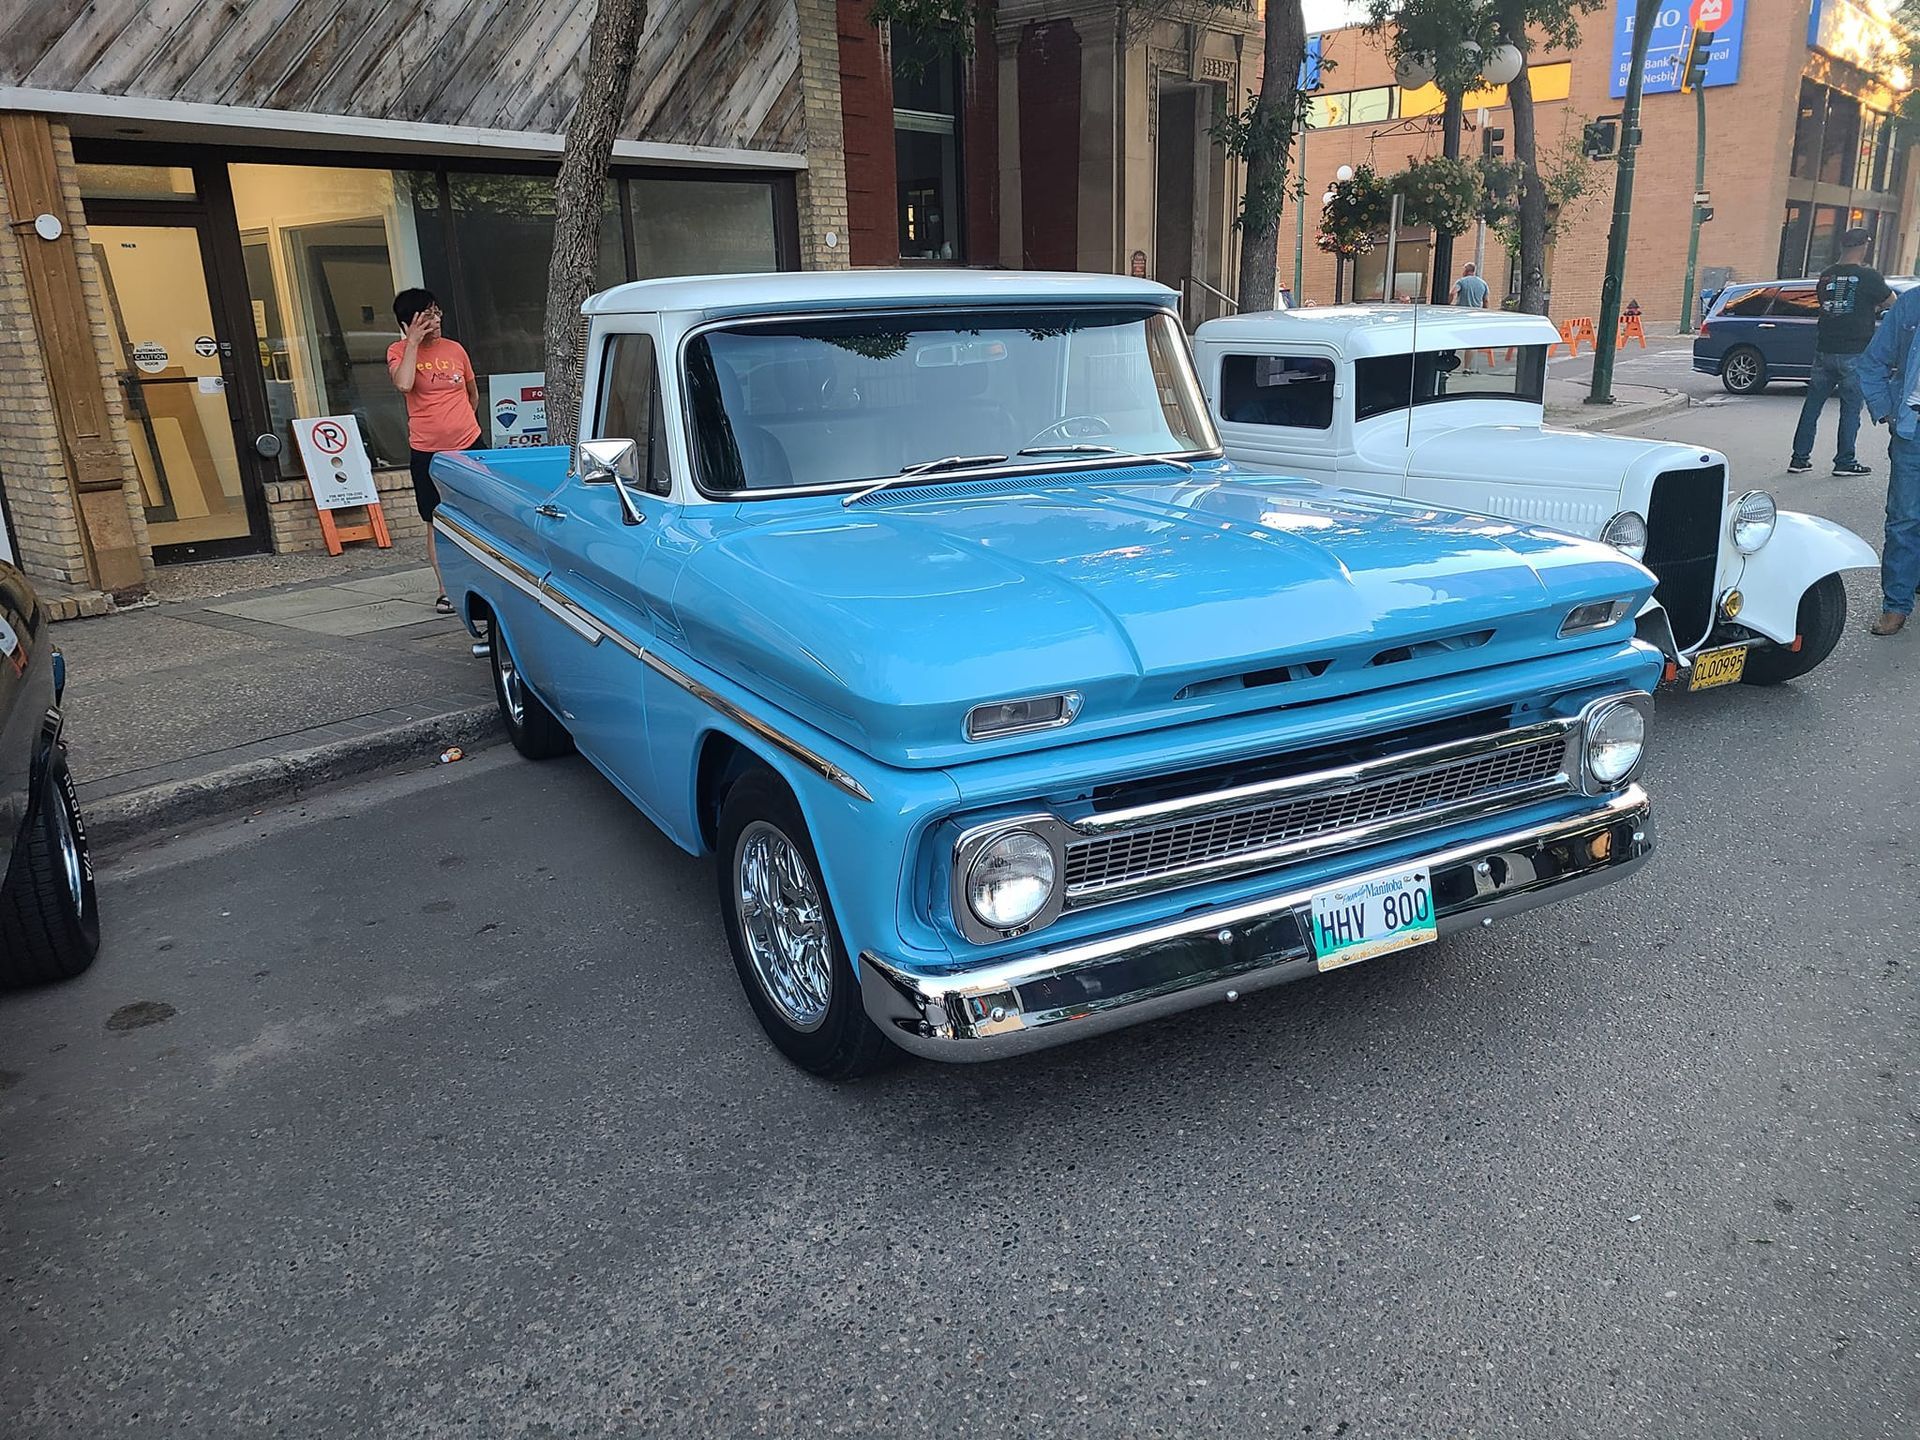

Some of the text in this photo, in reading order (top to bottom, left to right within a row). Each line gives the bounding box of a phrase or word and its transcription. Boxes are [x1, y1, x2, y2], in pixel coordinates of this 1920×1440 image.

[1644, 56, 1669, 70] Bank
[1643, 70, 1675, 84] Nesbi
[532, 390, 543, 398] FO
[323, 428, 338, 448] P
[508, 433, 542, 445] FOR
[1694, 653, 1744, 681] CL00995
[1364, 878, 1404, 899] Manitoba
[1320, 897, 1327, 908] T
[1320, 887, 1429, 949] HHV 800
